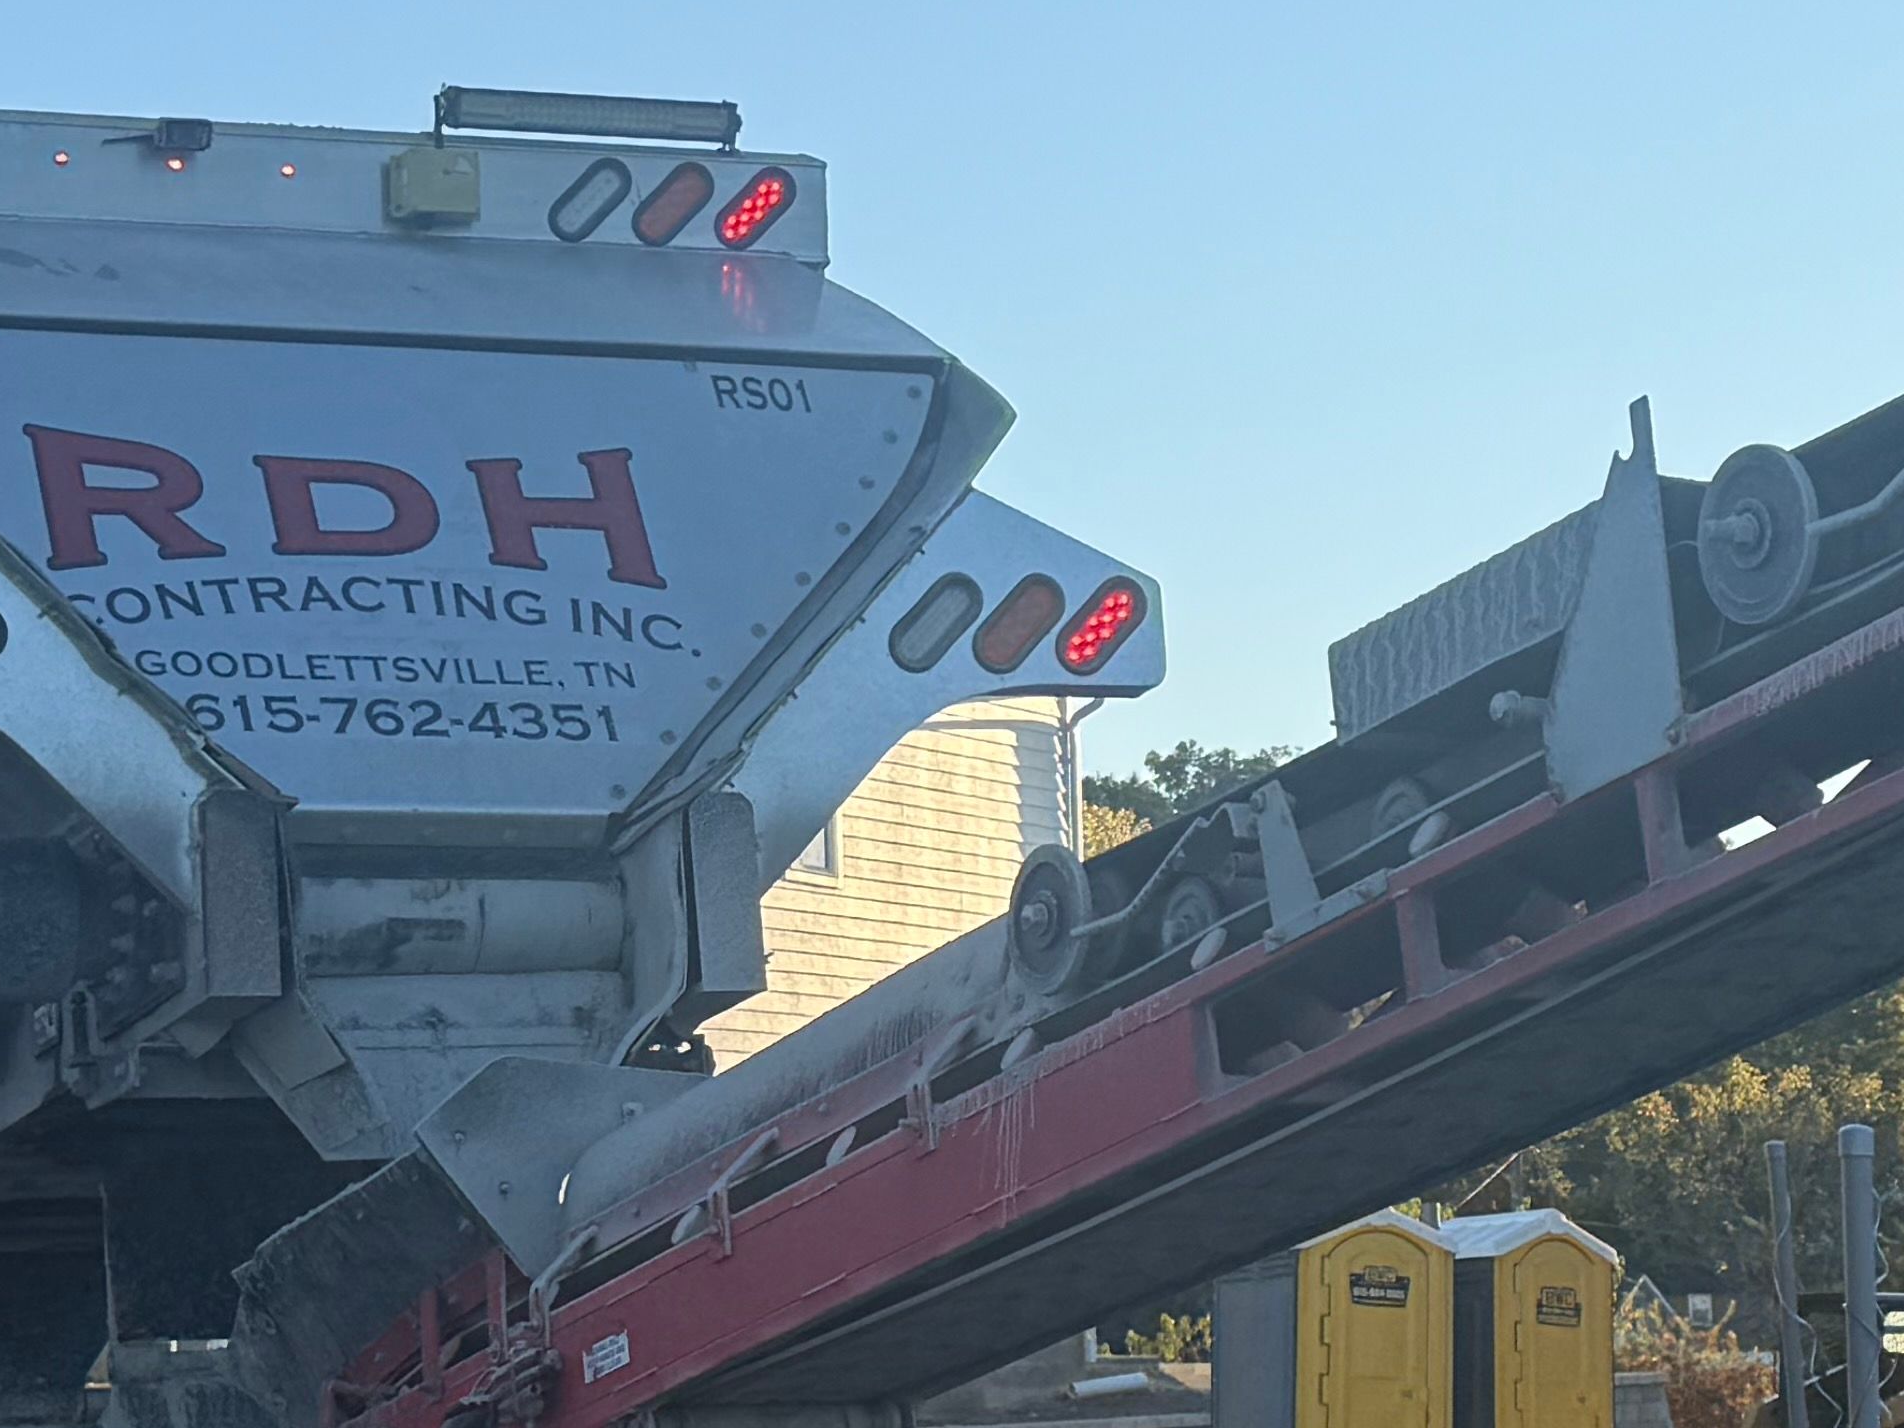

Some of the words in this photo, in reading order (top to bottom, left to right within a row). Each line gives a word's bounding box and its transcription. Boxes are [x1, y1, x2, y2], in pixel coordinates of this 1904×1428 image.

[710, 375, 811, 413] RS01
[22, 423, 667, 590] RDH
[570, 598, 701, 657] INC.
[134, 649, 566, 690] GOODLETTSVILLE,
[573, 661, 636, 688] TN
[185, 693, 619, 742] 615-762-4351
